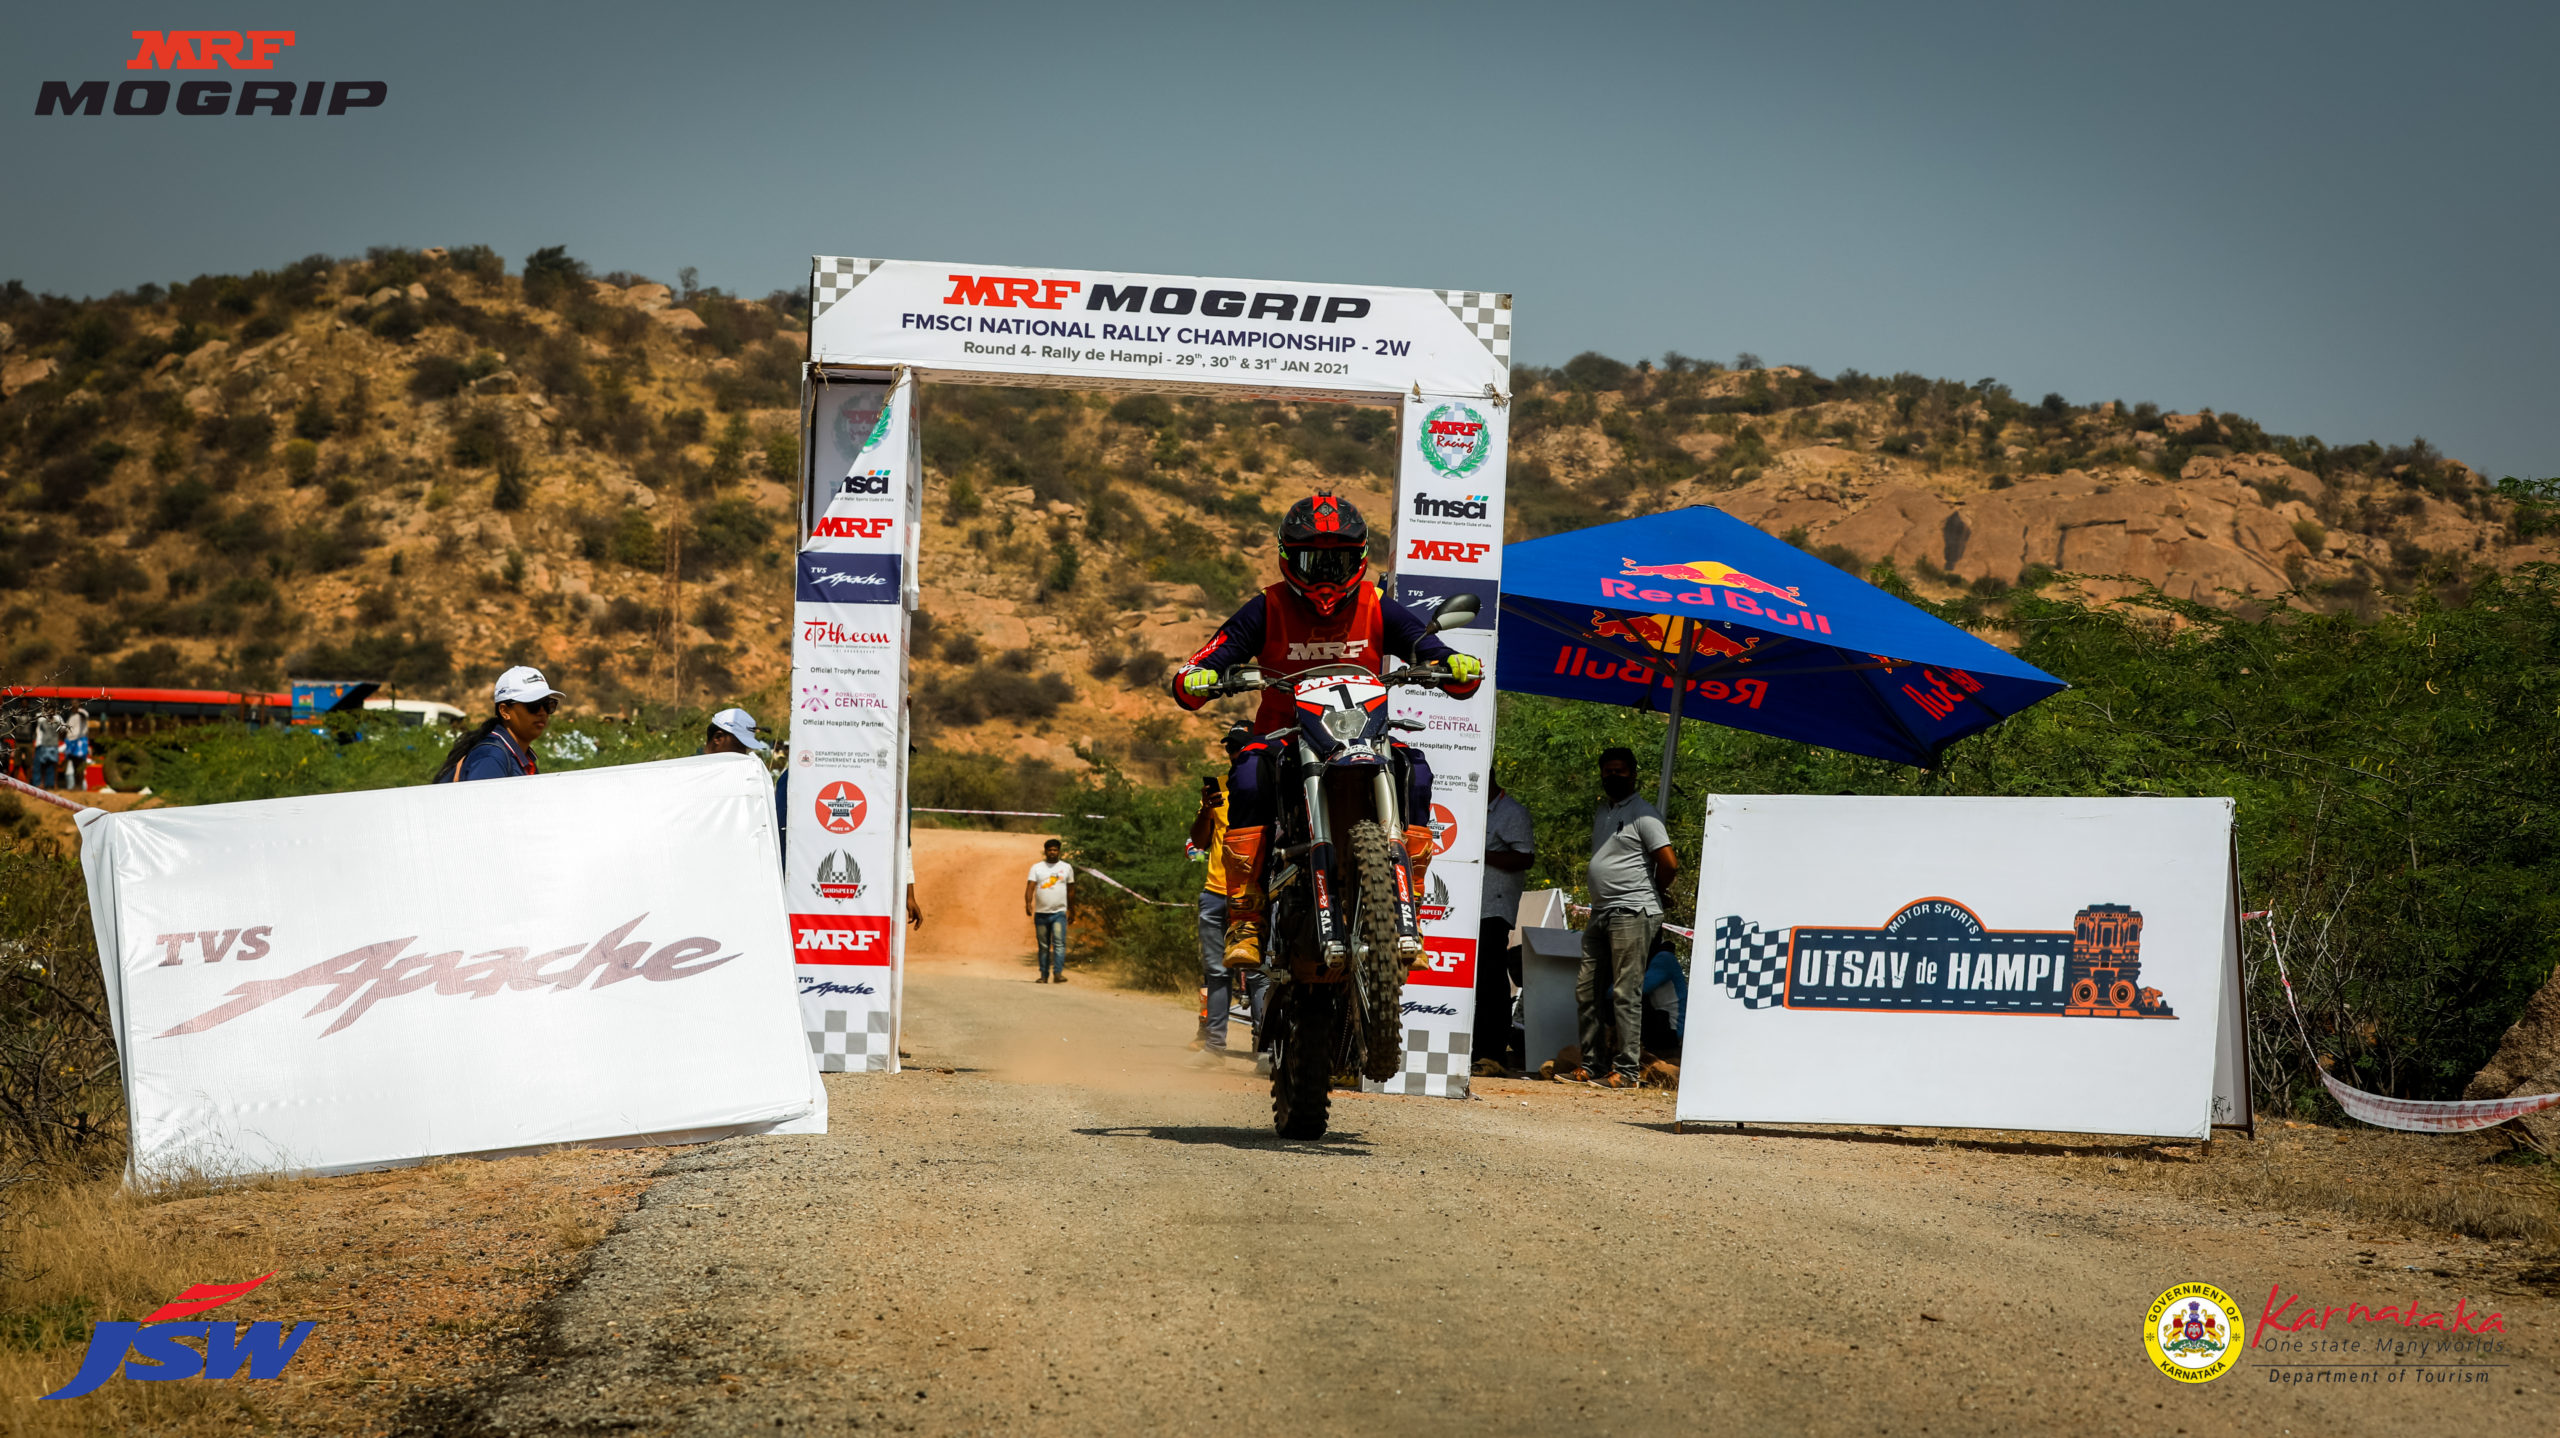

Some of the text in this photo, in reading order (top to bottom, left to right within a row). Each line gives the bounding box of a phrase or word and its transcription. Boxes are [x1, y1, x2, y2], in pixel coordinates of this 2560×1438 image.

[943, 275, 1371, 323] MRF MOGRIP
[902, 313, 972, 332] FMSCI
[979, 317, 1096, 339] NATIONAL
[1102, 323, 1171, 343] RALLY
[1177, 327, 1356, 353] CHAMPIONSHIP
[1375, 339, 1411, 357] 2W
[964, 341, 1016, 356] Round
[1020, 344, 1037, 357] 4-
[1041, 345, 1081, 362] Rally
[1085, 348, 1105, 361] de
[1110, 350, 1163, 367] Hampi
[1240, 358, 1251, 369] &
[1280, 360, 1310, 373] JAN
[1314, 362, 1349, 375] 2021
[1428, 420, 1482, 437] MRF
[1436, 434, 1474, 453] Racing
[1413, 492, 1488, 519] fmsci
[811, 517, 893, 538] MRF
[1407, 539, 1490, 563] MRF
[809, 571, 888, 587] Apache
[1600, 577, 1832, 635] Red Bull
[1287, 639, 1368, 660] MRF
[834, 667, 855, 675] Trophy
[1297, 675, 1375, 693] MRF
[834, 697, 888, 708] CENTRAL
[1328, 684, 1354, 709] 1
[1428, 720, 1481, 733] CENTRAL
[1420, 742, 1452, 750] Hospitality
[1316, 871, 1332, 934] TVS Racing
[1395, 866, 1414, 927] TVS Racing
[1888, 903, 1980, 935] MOTOR SPORTS
[154, 925, 273, 967] TVS
[795, 928, 880, 951] MRF
[1424, 950, 1465, 973] RF
[1799, 949, 2065, 992] UTSAV de HAMPI
[152, 911, 744, 1039] Apache
[800, 981, 877, 997] Apache
